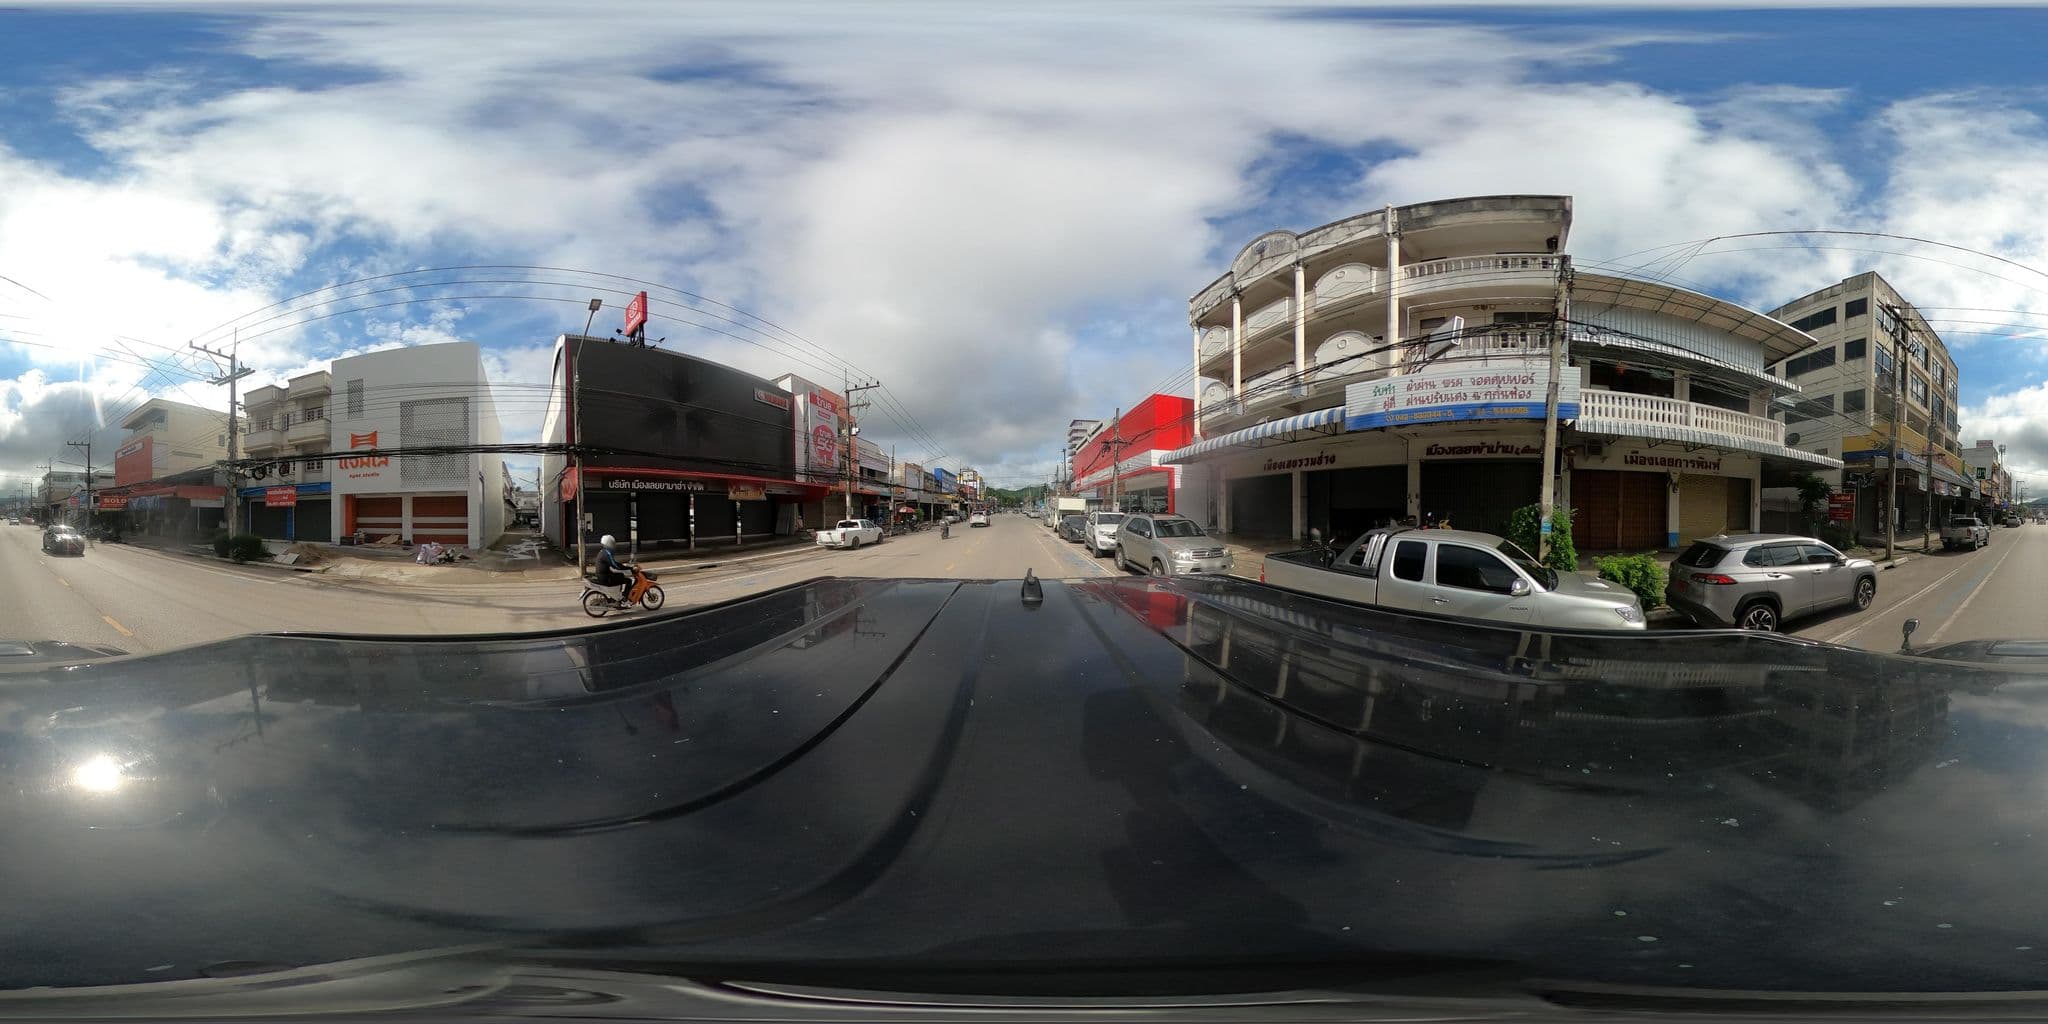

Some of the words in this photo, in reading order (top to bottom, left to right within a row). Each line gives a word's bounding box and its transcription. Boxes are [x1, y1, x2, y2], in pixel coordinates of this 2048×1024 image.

[1406, 378, 1437, 392] ผ้าม่าน
[816, 395, 832, 411] true
[1263, 450, 1336, 472] เมืองเลยรวมช่าง
[1623, 450, 1722, 471] เมืองเลยการพิมพ์
[608, 479, 631, 489] บริษัท
[631, 479, 686, 491] เมืองเลยยามาฮ่า
